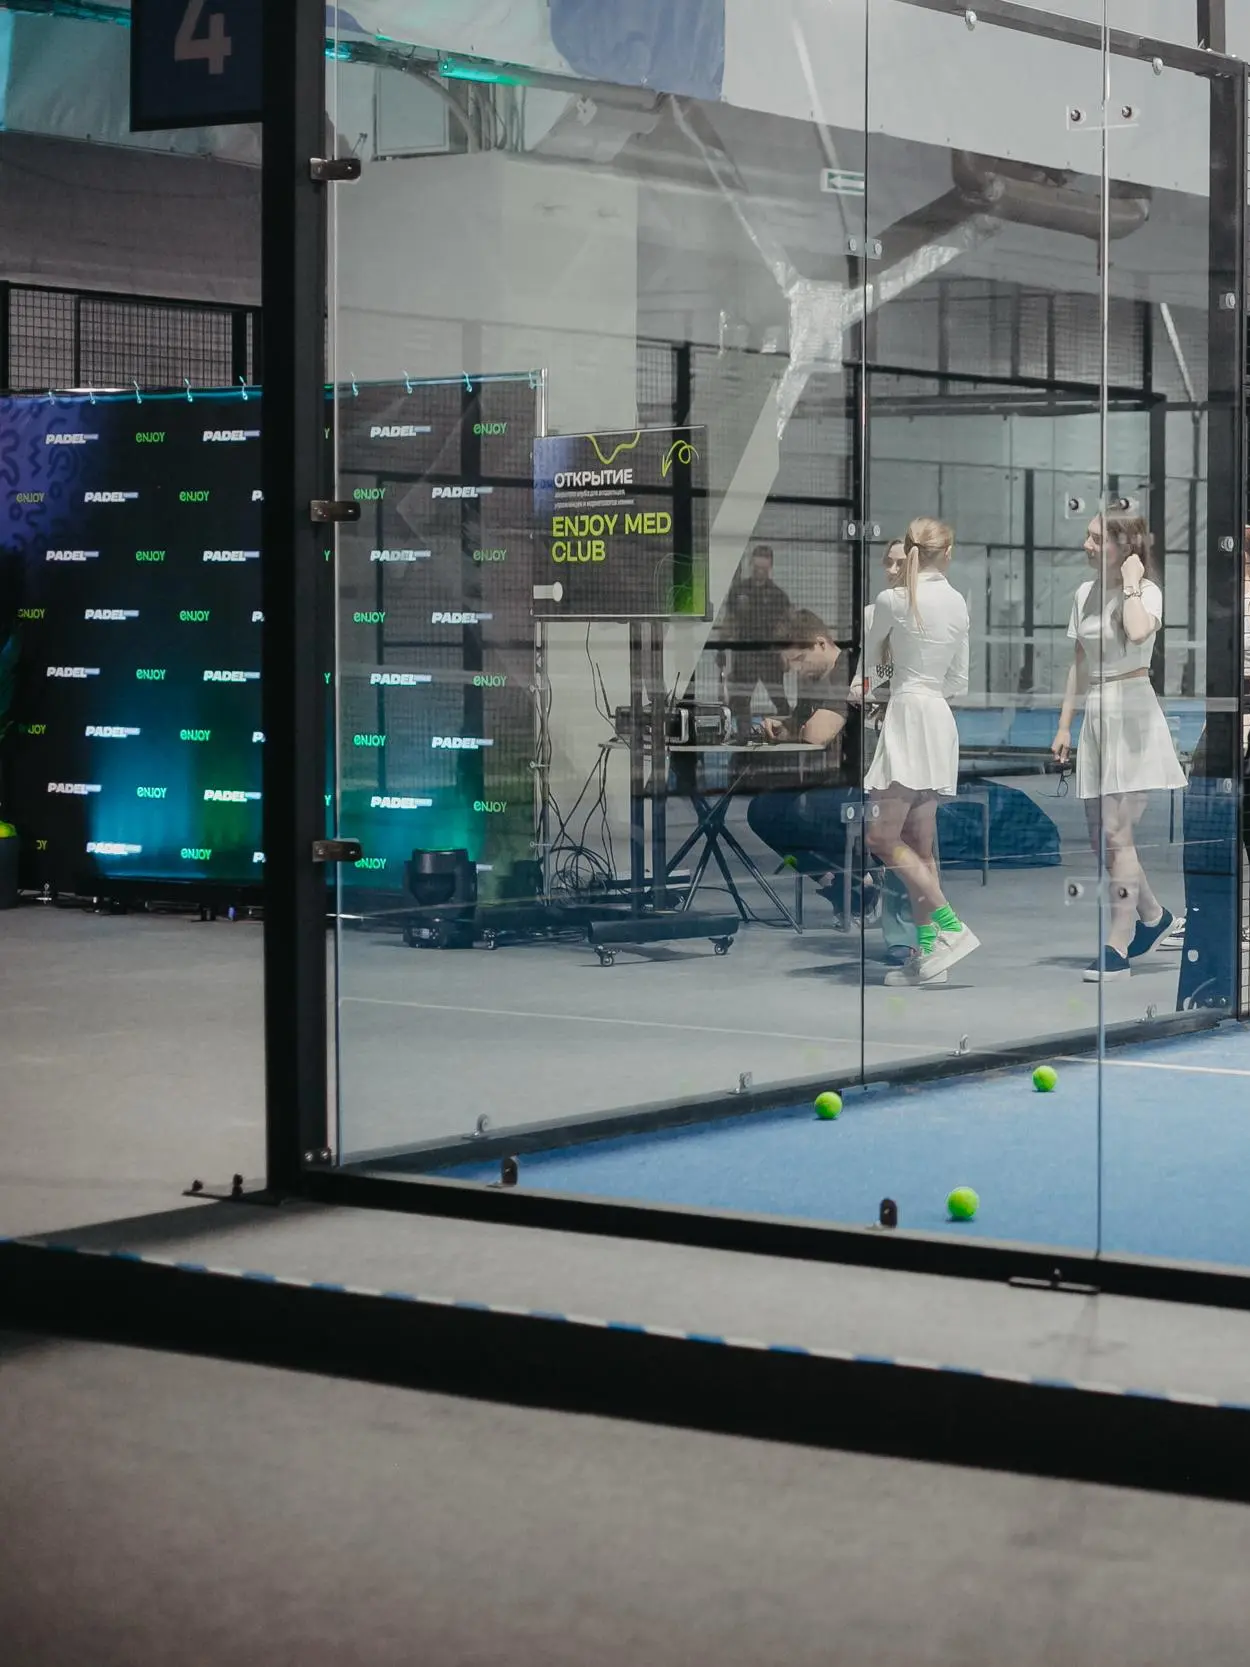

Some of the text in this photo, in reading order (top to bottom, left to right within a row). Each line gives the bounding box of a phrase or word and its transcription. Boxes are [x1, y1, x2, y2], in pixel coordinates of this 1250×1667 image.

[174, 0, 231, 74] 4
[203, 430, 247, 441] PADEL
[371, 426, 417, 437] PADEL
[46, 434, 87, 444] PADEL
[554, 468, 633, 489] ОТКРЫТИЕ
[85, 492, 126, 502] PADEL
[432, 487, 479, 498] PADEL
[552, 512, 672, 537] ENJOY MED
[46, 551, 87, 561] PADEL
[203, 551, 247, 561] PADEL
[370, 550, 417, 561] PADEL
[551, 540, 606, 563] CLUB
[85, 609, 127, 620] PADEL
[432, 612, 479, 623] PADEL
[47, 667, 88, 678] PADEL
[204, 671, 248, 681] PADEL
[371, 674, 418, 685] PADEL
[86, 726, 128, 737] PADEL
[432, 737, 479, 748] PADEL
[48, 783, 89, 794] PADEL
[204, 790, 248, 802] PADEL
[371, 797, 418, 809] PADEL
[87, 842, 129, 855] PADEL
